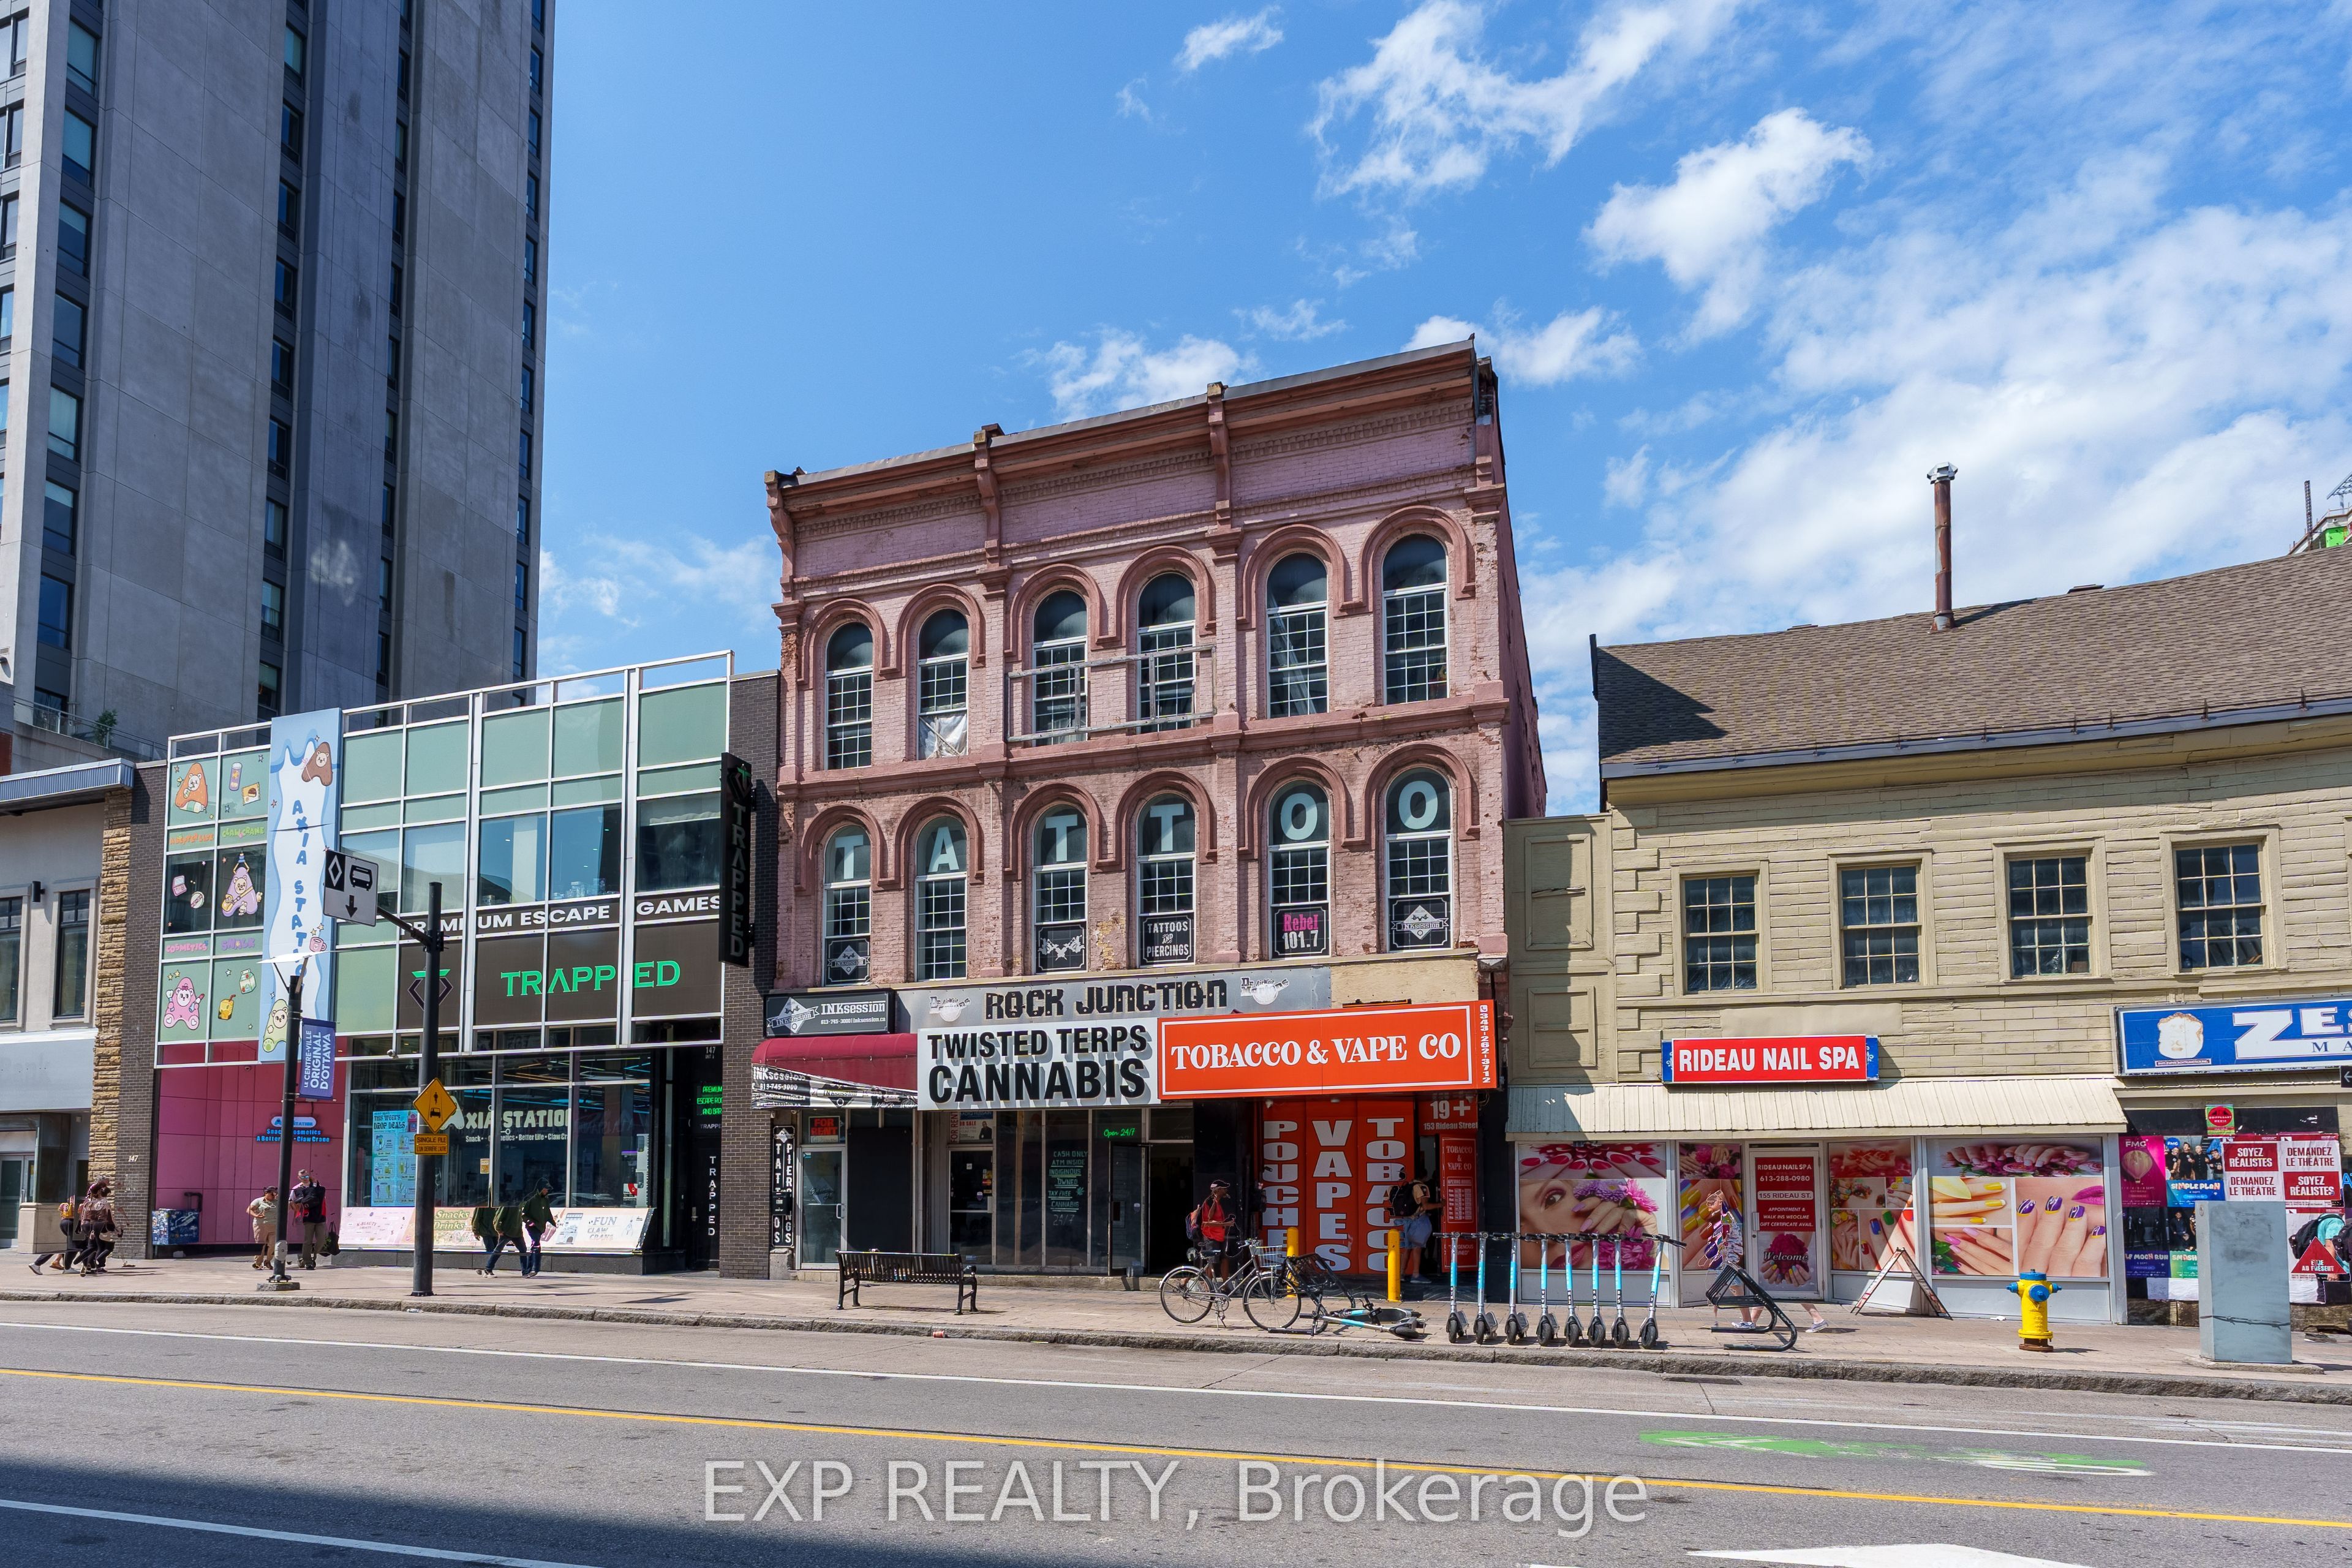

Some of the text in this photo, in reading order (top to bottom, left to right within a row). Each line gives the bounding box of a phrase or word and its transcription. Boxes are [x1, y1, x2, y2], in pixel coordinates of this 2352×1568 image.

[292, 800, 309, 865] AXIA
[729, 801, 747, 957] TRAPPED
[401, 895, 720, 935] PRMIUM ESCAPE GAMES
[1147, 921, 1188, 933] TATTOOS
[1284, 914, 1319, 932] Rebel
[1162, 933, 1174, 944] AND
[1282, 930, 1319, 949] 101.7
[166, 942, 208, 953] COSMETICS
[1147, 944, 1189, 957] PIERCINGS
[500, 960, 680, 997] TRAPPED
[986, 978, 1227, 1020] ROCK JUNCTION
[821, 1000, 886, 1015] INKsession
[2232, 1006, 2352, 1060] ZE
[927, 1025, 1147, 1060] TWISTED TERPS
[1480, 1013, 1491, 1083] 343-262-3712
[1171, 1033, 1461, 1070] TOBACCO & VAPE CO
[311, 1032, 322, 1088] ORIGINAL
[320, 1033, 331, 1090] D'OTTAWA
[1679, 1046, 1860, 1072] RIDEAU NAIL SPA
[929, 1058, 1146, 1104] CANNABIS
[503, 1109, 568, 1128] STATIO
[814, 1118, 834, 1127] FOR
[811, 1127, 838, 1136] RENT
[1104, 1128, 1135, 1138] Open 24/7
[1446, 1145, 1472, 1154] TOBACCO
[2237, 1147, 2263, 1157] SOYEZ
[2287, 1147, 2332, 1156] DEMANDEZ
[2229, 1157, 2272, 1167] RÉALISTES
[2286, 1158, 2295, 1167] LE
[2231, 1177, 2274, 1185] DEMANDEZ
[2298, 1176, 2324, 1185] SOYEZ
[708, 1156, 717, 1235] TRAPPED
[1312, 1120, 1352, 1272] VAPES
[2230, 1187, 2238, 1196] LE
[2290, 1185, 2334, 1196] RÉALISTES
[435, 1210, 470, 1220] Snacks
[592, 1216, 618, 1225] FUN
[1053, 1214, 1075, 1226] 24/7
[434, 1221, 466, 1231] Drinks
[1763, 1251, 1808, 1261] Welcome
